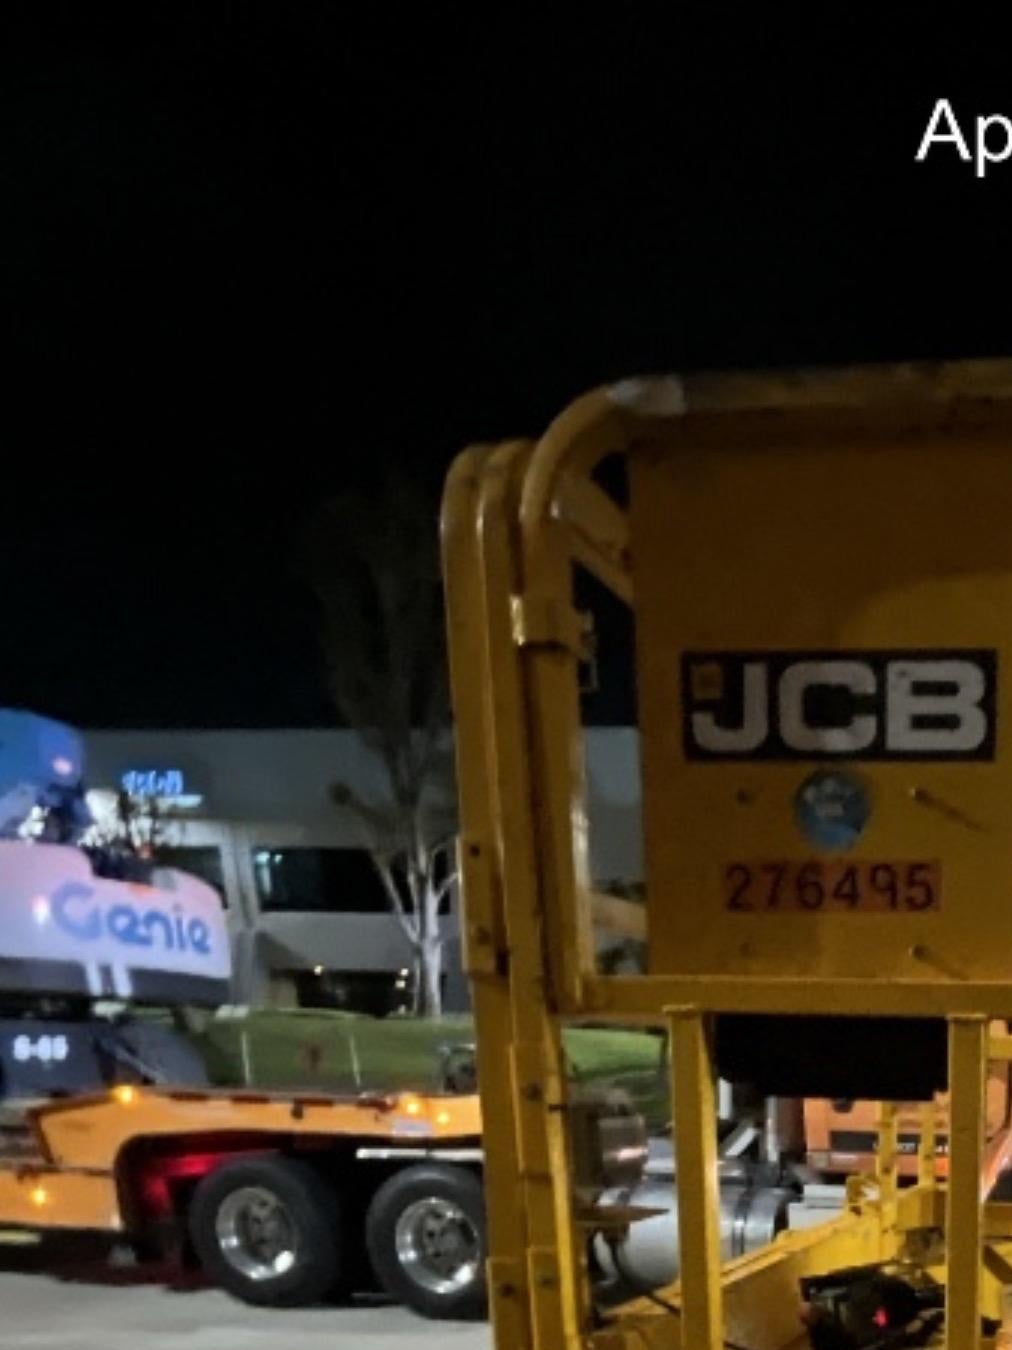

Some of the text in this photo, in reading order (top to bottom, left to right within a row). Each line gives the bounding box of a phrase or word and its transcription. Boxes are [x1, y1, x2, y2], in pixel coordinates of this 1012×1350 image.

[690, 659, 989, 753] JCB
[50, 879, 212, 955] Genie
[725, 863, 936, 912] 276495
